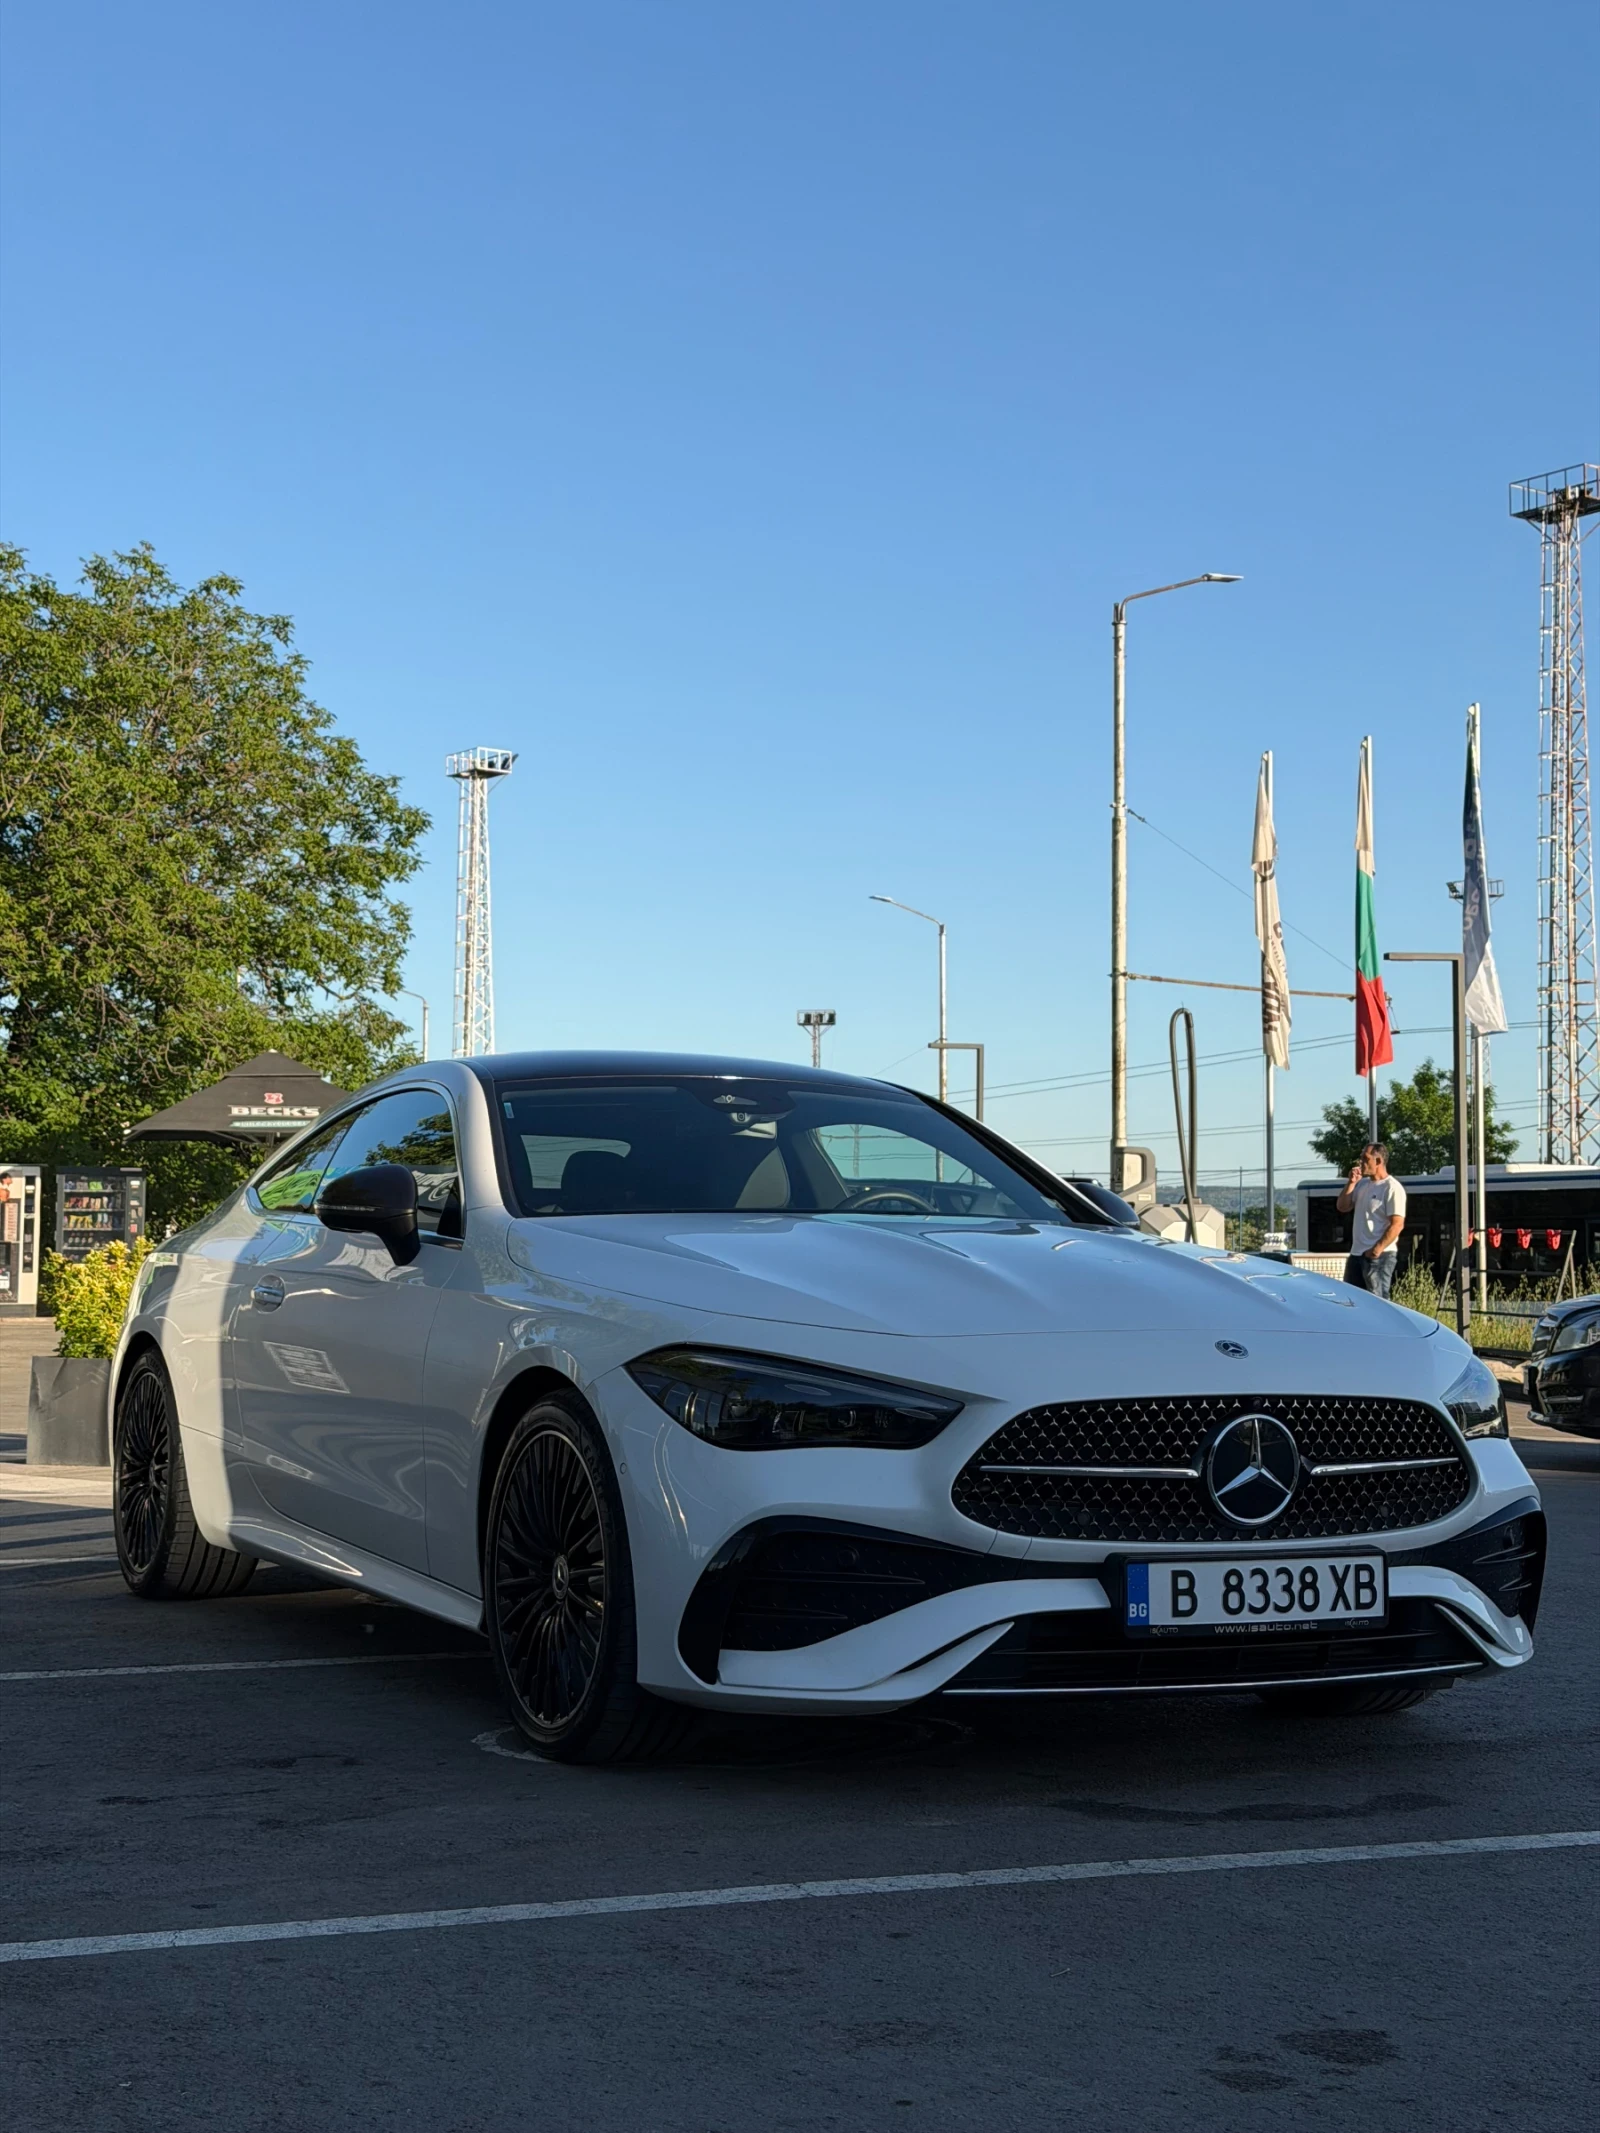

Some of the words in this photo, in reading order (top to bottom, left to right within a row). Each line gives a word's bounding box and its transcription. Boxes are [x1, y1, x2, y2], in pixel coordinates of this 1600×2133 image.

[228, 1105, 321, 1118] BECK'S
[1171, 1569, 1198, 1618] B
[1222, 1565, 1320, 1615] 8338
[1328, 1563, 1378, 1612] XB
[1128, 1602, 1148, 1618] BG
[1214, 1621, 1318, 1634] www.isauto.net
